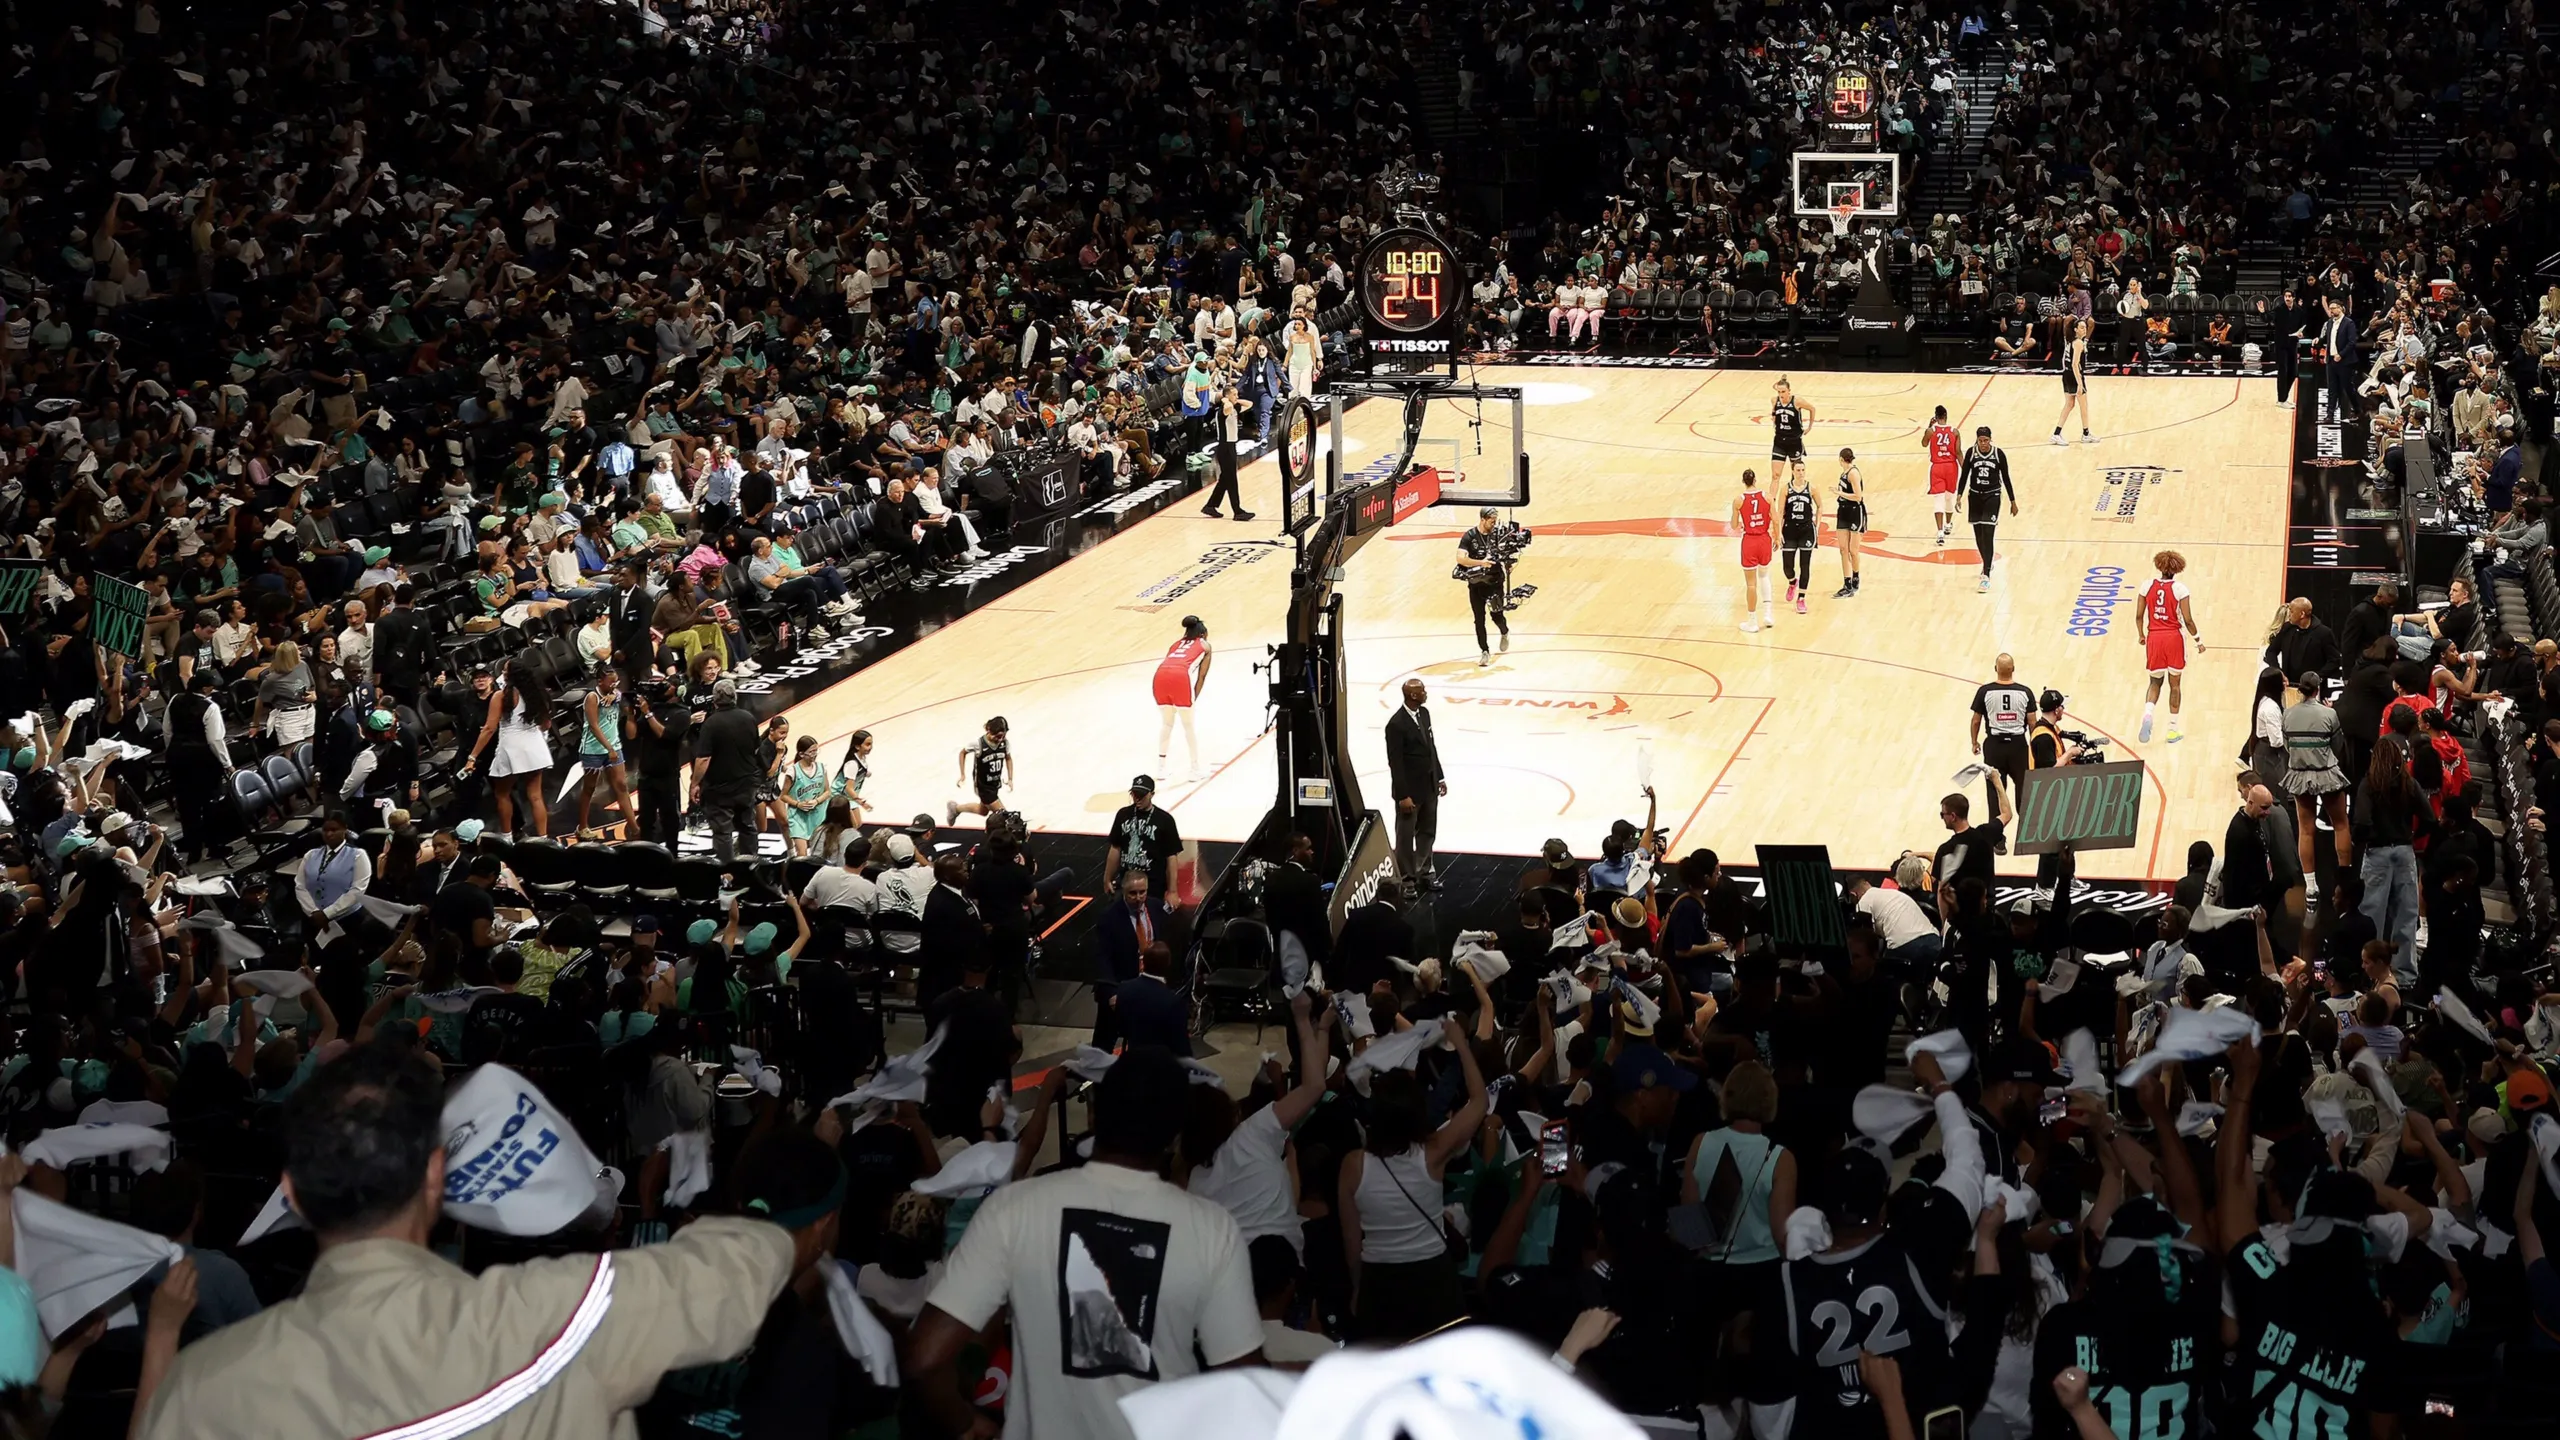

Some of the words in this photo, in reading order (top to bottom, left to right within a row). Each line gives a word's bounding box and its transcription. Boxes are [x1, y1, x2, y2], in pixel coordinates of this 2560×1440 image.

[1836, 77, 1867, 90] 10:00
[1834, 90, 1866, 113] 24
[1863, 226, 1882, 237] ally
[1386, 251, 1441, 274] 10:00
[1382, 276, 1437, 318] 24
[1391, 340, 1450, 351] TISSOT
[1781, 415, 1788, 423] 13
[1937, 433, 1950, 446] 24
[1978, 467, 1989, 477] 35
[1751, 500, 1759, 514] 7
[1792, 501, 1804, 512] 20
[122, 582, 149, 616] SOME
[2066, 566, 2135, 636] coinbase
[2157, 590, 2165, 605] 3
[94, 599, 146, 658] NOISE
[791, 626, 894, 665] Google
[736, 665, 819, 694] Pixel
[1444, 697, 1597, 709] WNBA
[2003, 694, 2011, 711] 9
[989, 759, 1002, 773] 30
[2017, 772, 2141, 844] LOUDER
[1344, 855, 1394, 920] coinbase
[470, 1007, 525, 1029] LIBERTY
[1811, 1285, 1911, 1367] 22
[2257, 1321, 2297, 1366] BIG
[2299, 1349, 2366, 1394] LLIE
